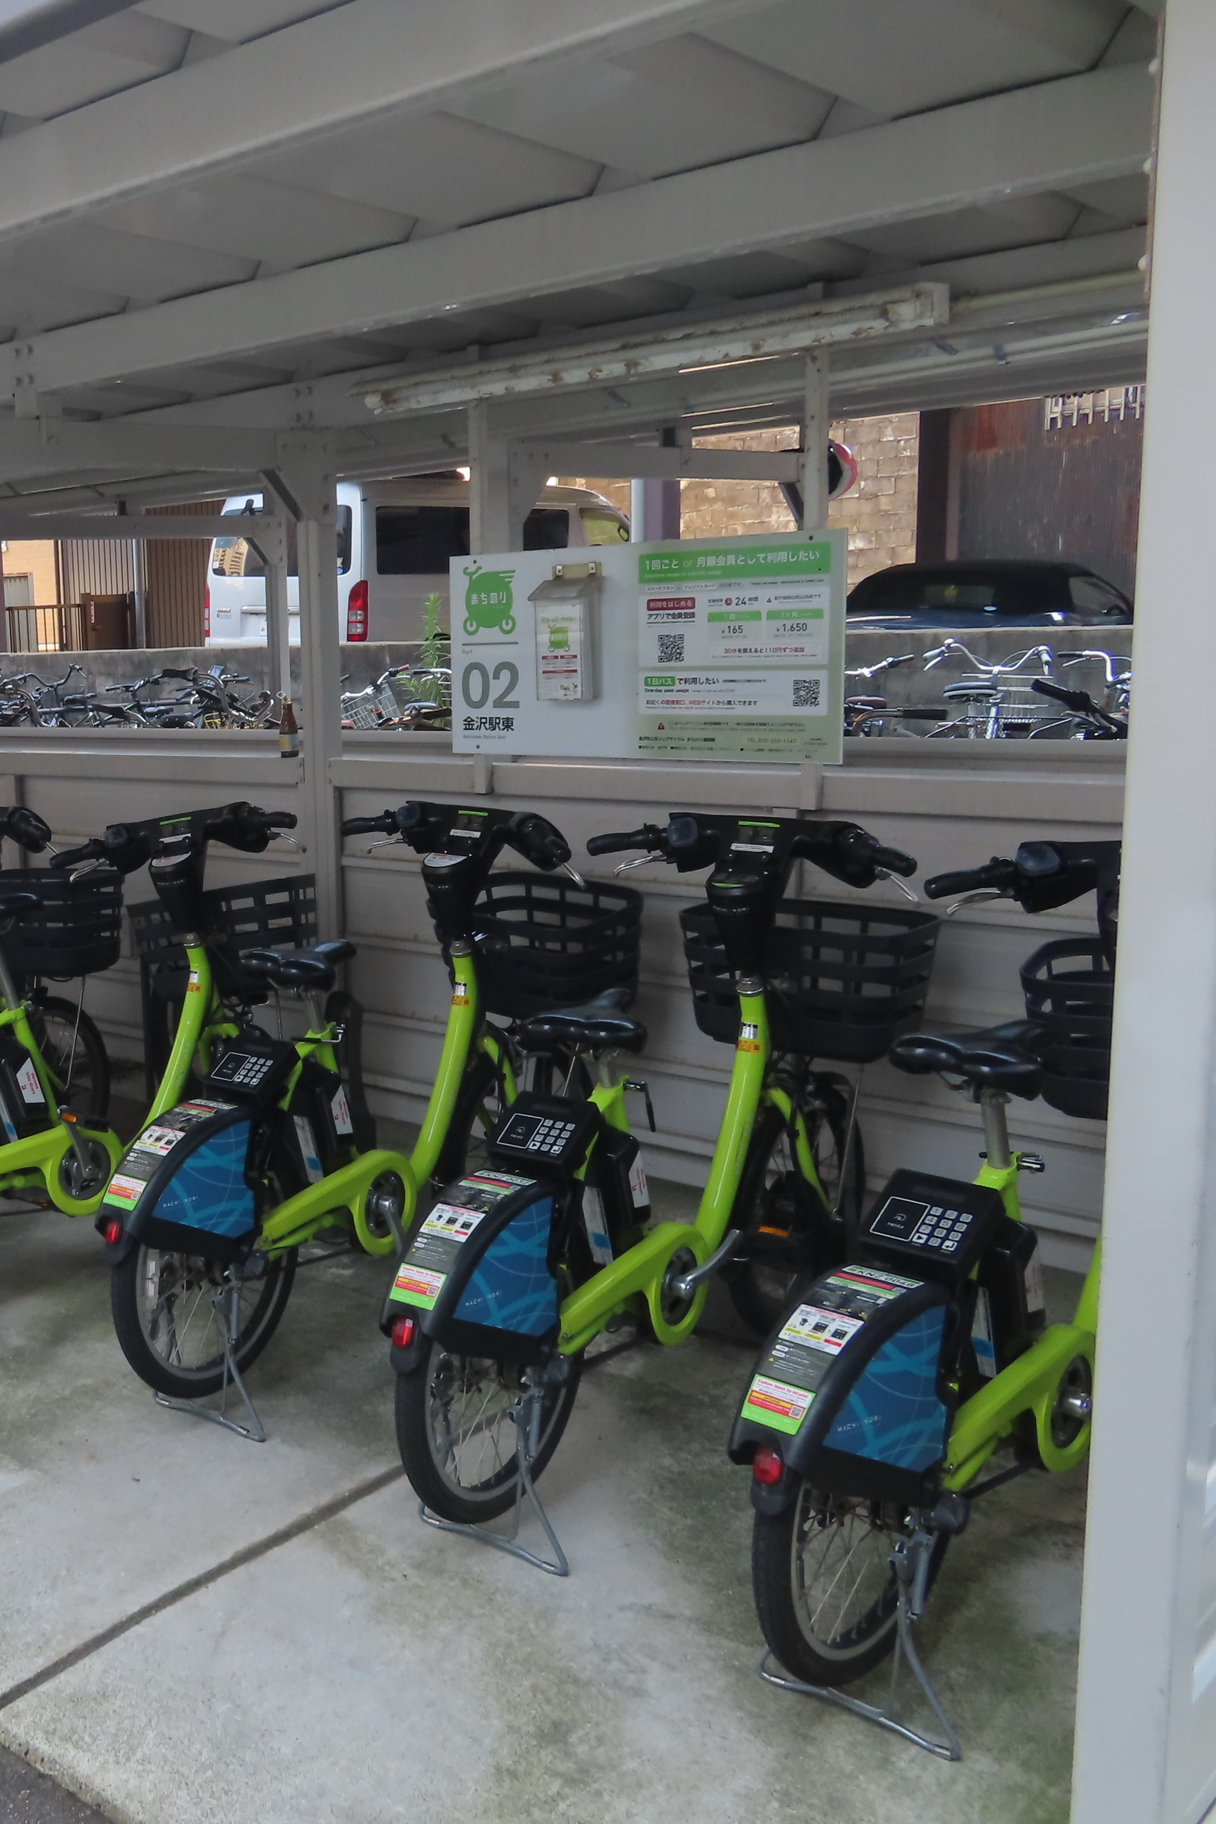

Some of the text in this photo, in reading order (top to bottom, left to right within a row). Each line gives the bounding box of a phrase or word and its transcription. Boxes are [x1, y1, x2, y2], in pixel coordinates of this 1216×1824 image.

[471, 591, 506, 605] まちのり
[735, 596, 747, 607] 24
[462, 661, 520, 709] 02
[463, 716, 514, 732] 金沢駅東
